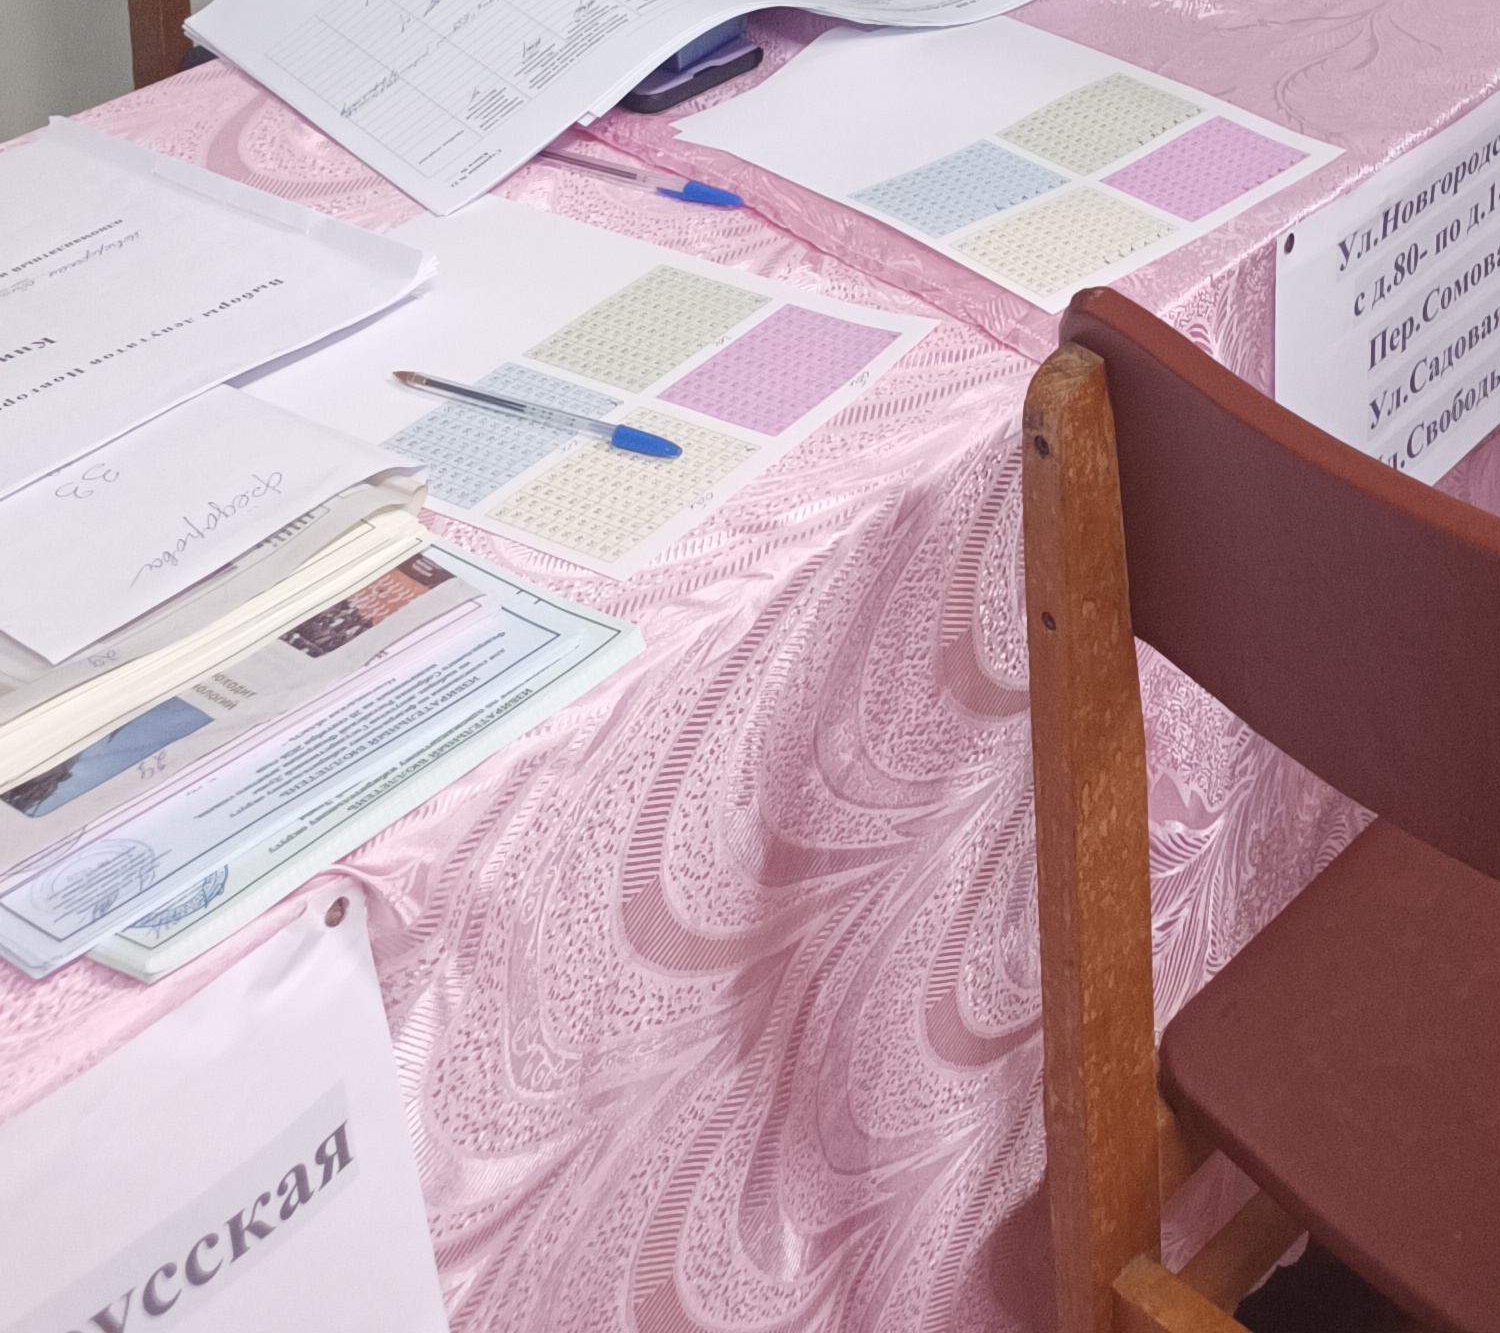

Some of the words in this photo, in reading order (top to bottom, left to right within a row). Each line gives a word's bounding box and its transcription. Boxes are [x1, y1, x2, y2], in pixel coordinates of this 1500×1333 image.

[1354, 288, 1366, 317] с
[1434, 218, 1461, 256] по
[370, 675, 480, 746] ИЗБИРАТЕЛЬНЫЙ
[428, 687, 533, 761] ИЗБИРАТЕЛЬНЫЙ
[279, 740, 367, 798] БЮЛЛЕТЕНЬ
[346, 754, 429, 812] БЮЛЛЕТЕНЬ
[62, 1119, 355, 1333] усская
